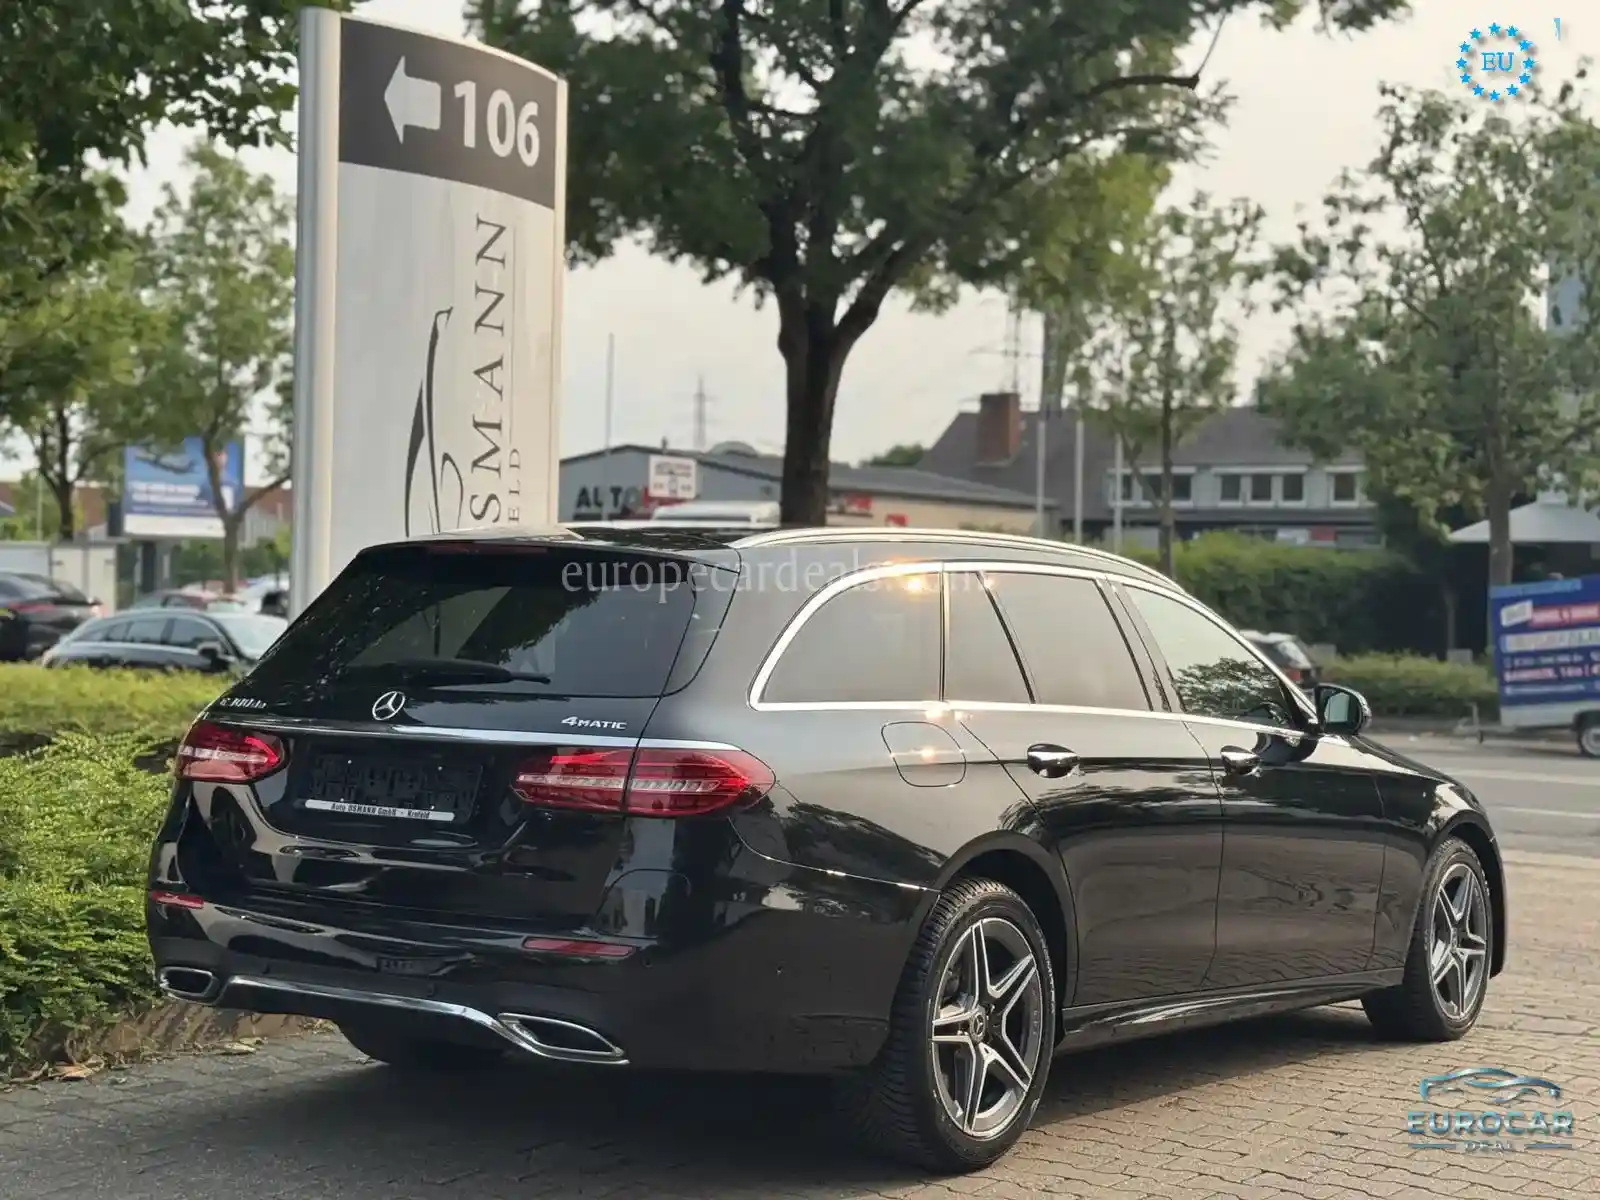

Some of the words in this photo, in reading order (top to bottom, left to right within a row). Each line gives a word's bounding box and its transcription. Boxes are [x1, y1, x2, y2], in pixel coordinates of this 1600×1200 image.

[454, 80, 540, 167] 106
[561, 716, 628, 730] 4MATIC
[378, 806, 397, 816] GmbH
